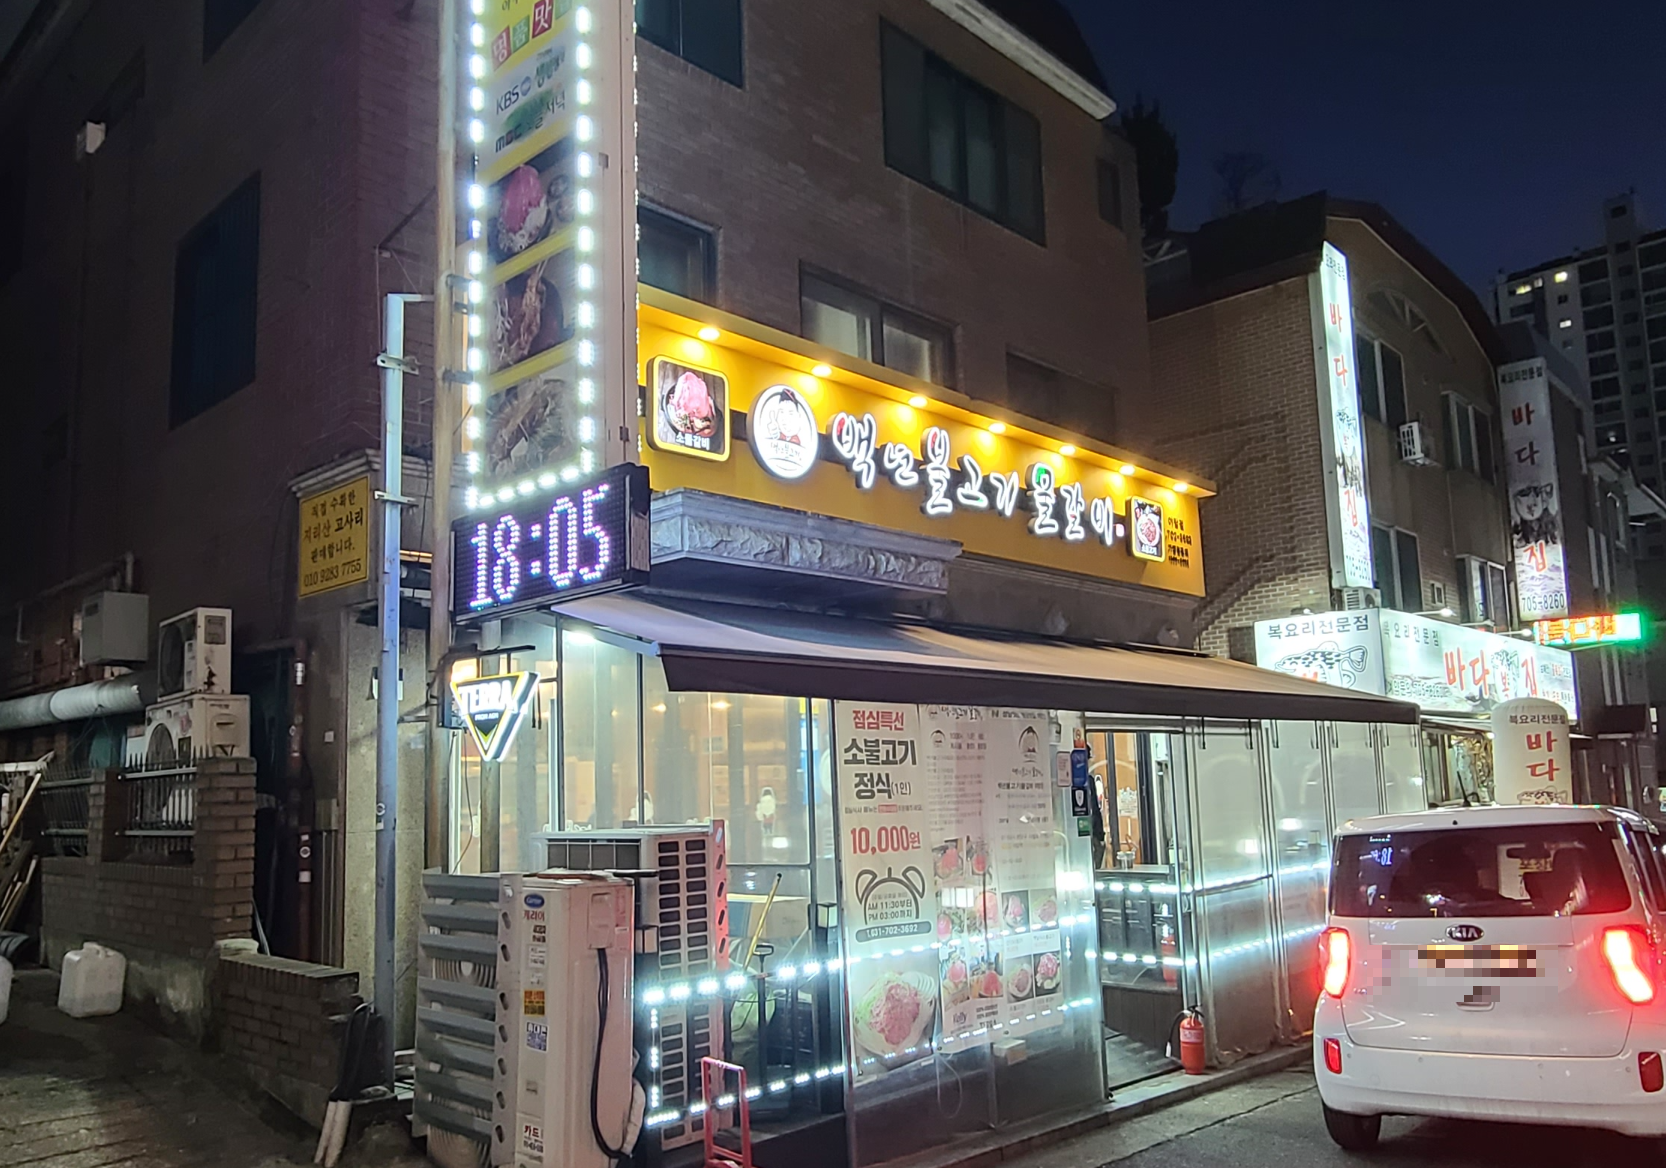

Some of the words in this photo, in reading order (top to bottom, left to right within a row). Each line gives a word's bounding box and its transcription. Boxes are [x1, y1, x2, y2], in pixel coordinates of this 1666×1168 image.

[496, 85, 520, 115] KBS
[1329, 302, 1358, 528] 바다집
[311, 500, 328, 518] 직접
[330, 489, 356, 512] 수확한
[303, 519, 332, 543] 지리산
[334, 507, 364, 532] 고사리
[310, 536, 356, 563] 판매합니다.
[469, 483, 610, 608] 18:05
[304, 573, 319, 587] 010
[320, 565, 340, 583] 9283
[341, 558, 362, 576] 7755
[1522, 592, 1566, 613] 705-8260
[1267, 616, 1369, 641] 복요리전문점
[1383, 620, 1440, 648] 복요리전문점
[852, 709, 904, 731] 점심특선
[1509, 714, 1566, 725] 복요리전문점
[843, 738, 917, 766] 소불고기
[1525, 730, 1561, 782] 바다
[854, 772, 912, 799] 정식(1인)
[850, 825, 921, 855] 10,000원
[868, 901, 878, 911] AM
[880, 899, 912, 910] 11:30부터
[868, 912, 878, 921] PM
[879, 909, 912, 920] 03:00까지
[1451, 926, 1479, 939] KIA
[524, 1125, 540, 1138] 카드
